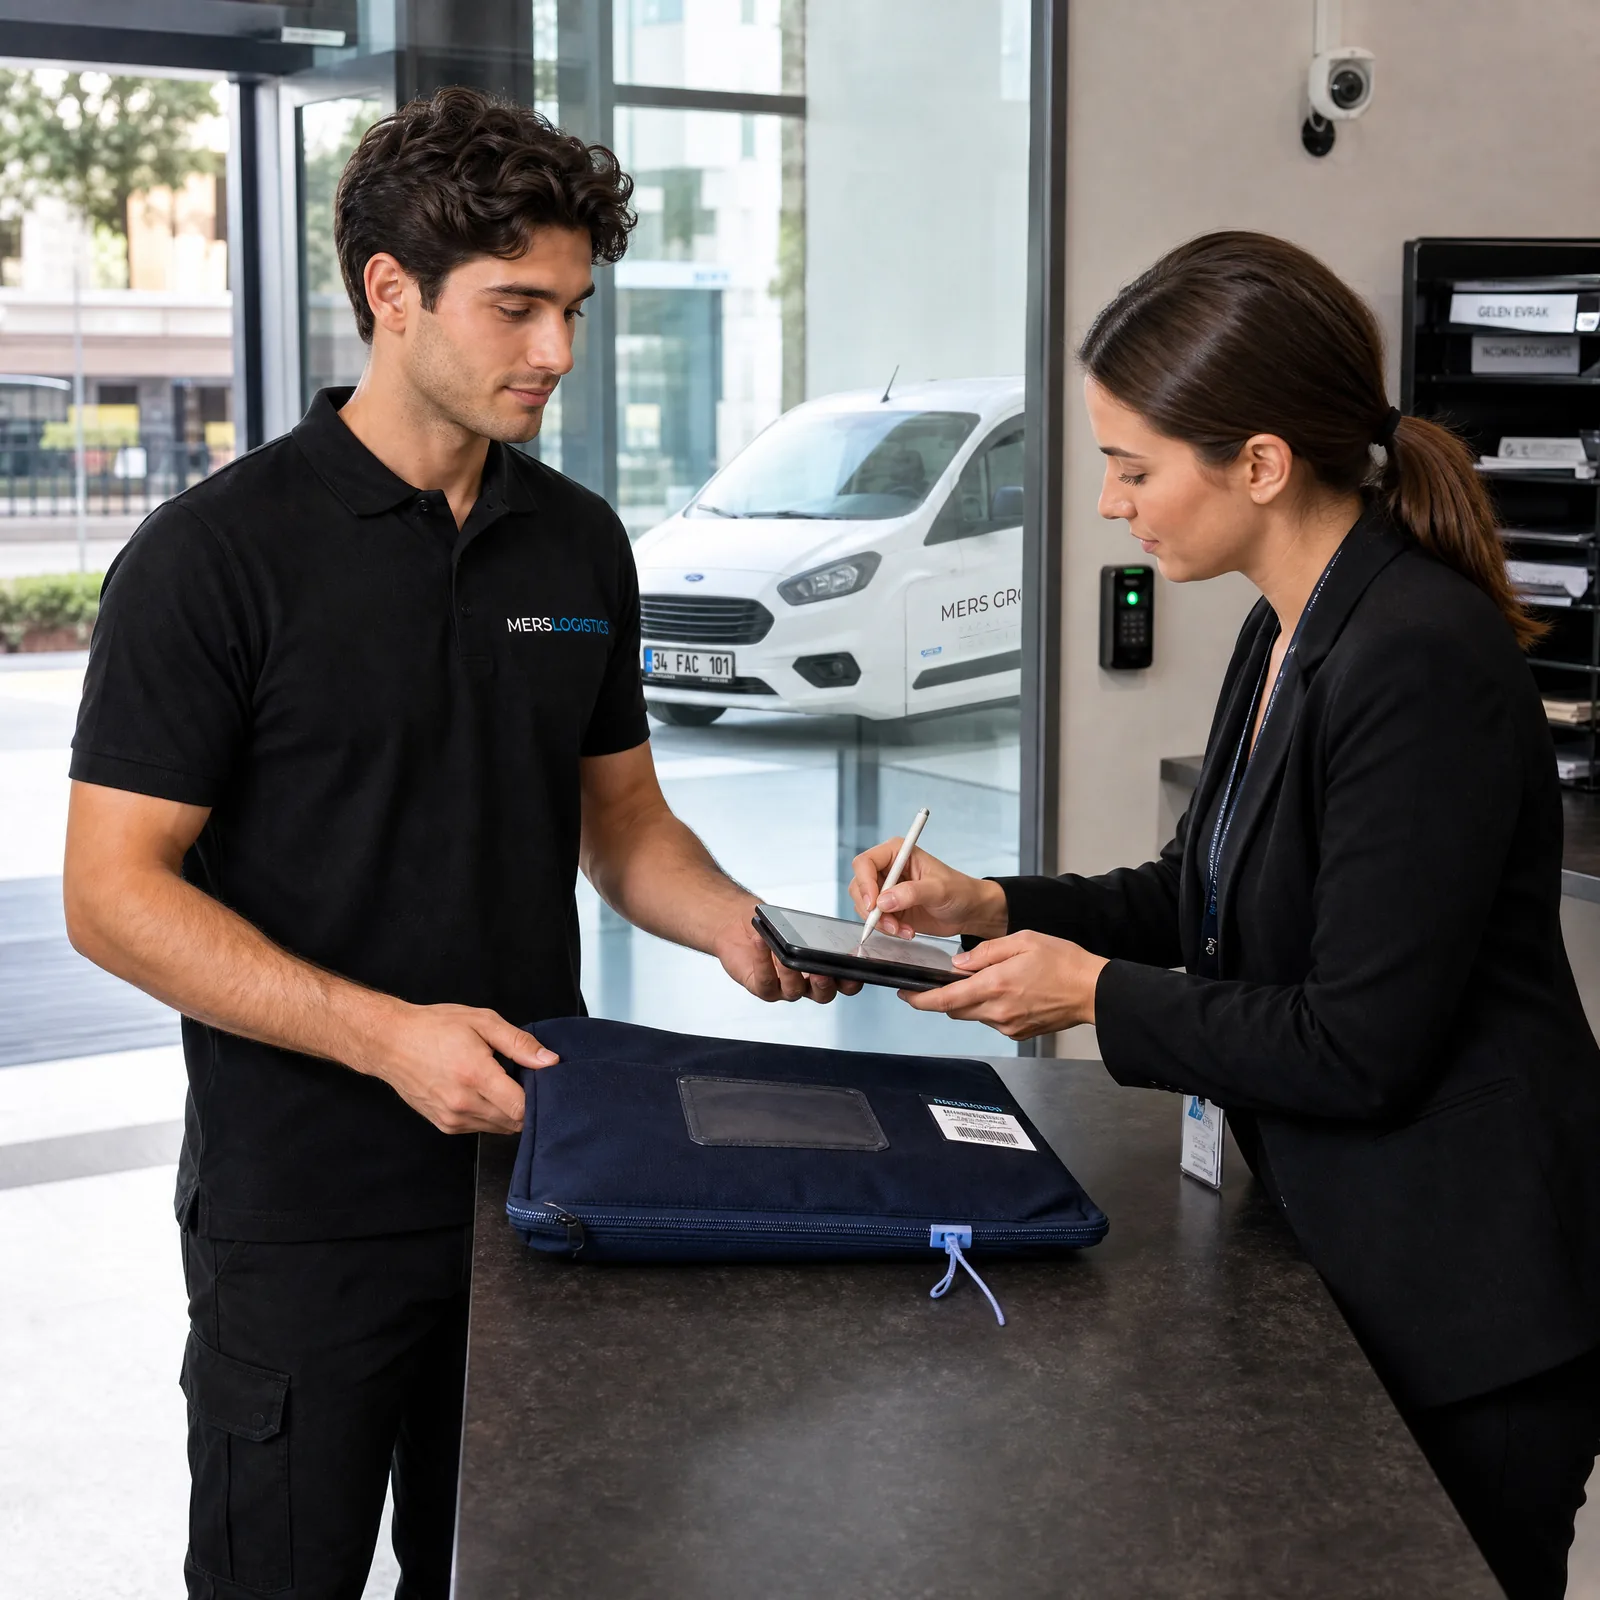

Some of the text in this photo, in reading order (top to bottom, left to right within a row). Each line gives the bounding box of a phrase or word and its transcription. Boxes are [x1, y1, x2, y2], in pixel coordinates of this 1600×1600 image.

[1478, 306, 1549, 318] GELEN EVRAK
[941, 588, 1021, 621] MERS GR
[653, 653, 729, 675] 34 FAC 101
